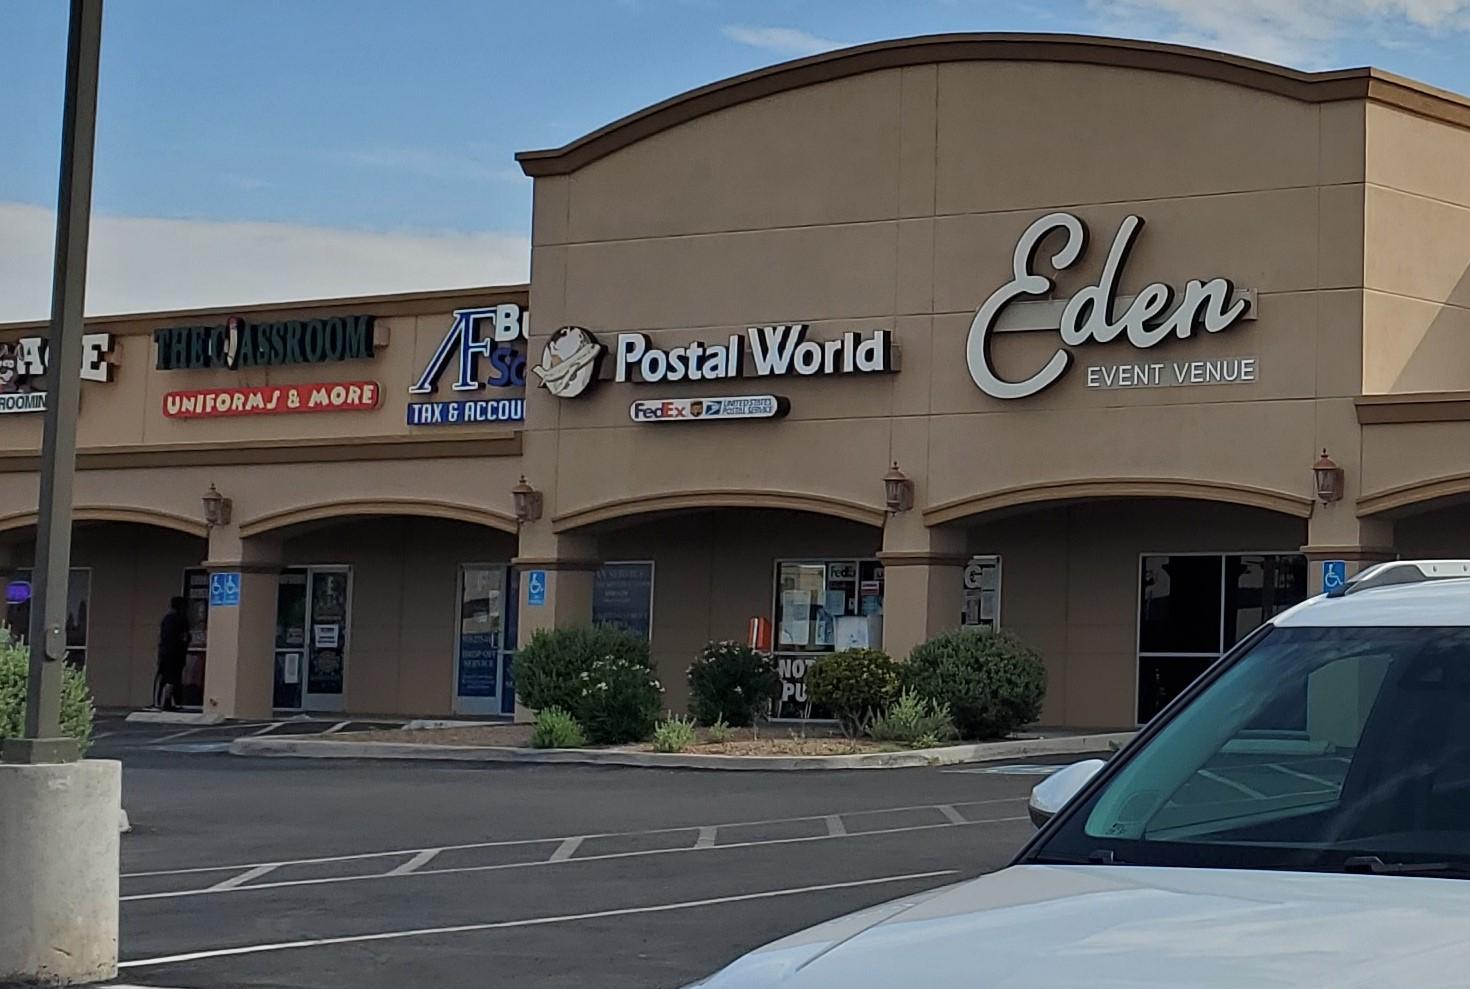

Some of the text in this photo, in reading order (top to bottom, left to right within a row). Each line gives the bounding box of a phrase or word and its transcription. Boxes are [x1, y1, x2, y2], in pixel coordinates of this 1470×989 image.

[967, 212, 1248, 400] Eden
[157, 328, 206, 369] THE
[615, 325, 884, 383] Postal World
[1087, 360, 1255, 387] EVENT VENUE
[166, 385, 374, 414] UNIFORMS & MORE
[412, 400, 527, 424] TAX & ACCOU
[634, 402, 686, 419] FedEx
